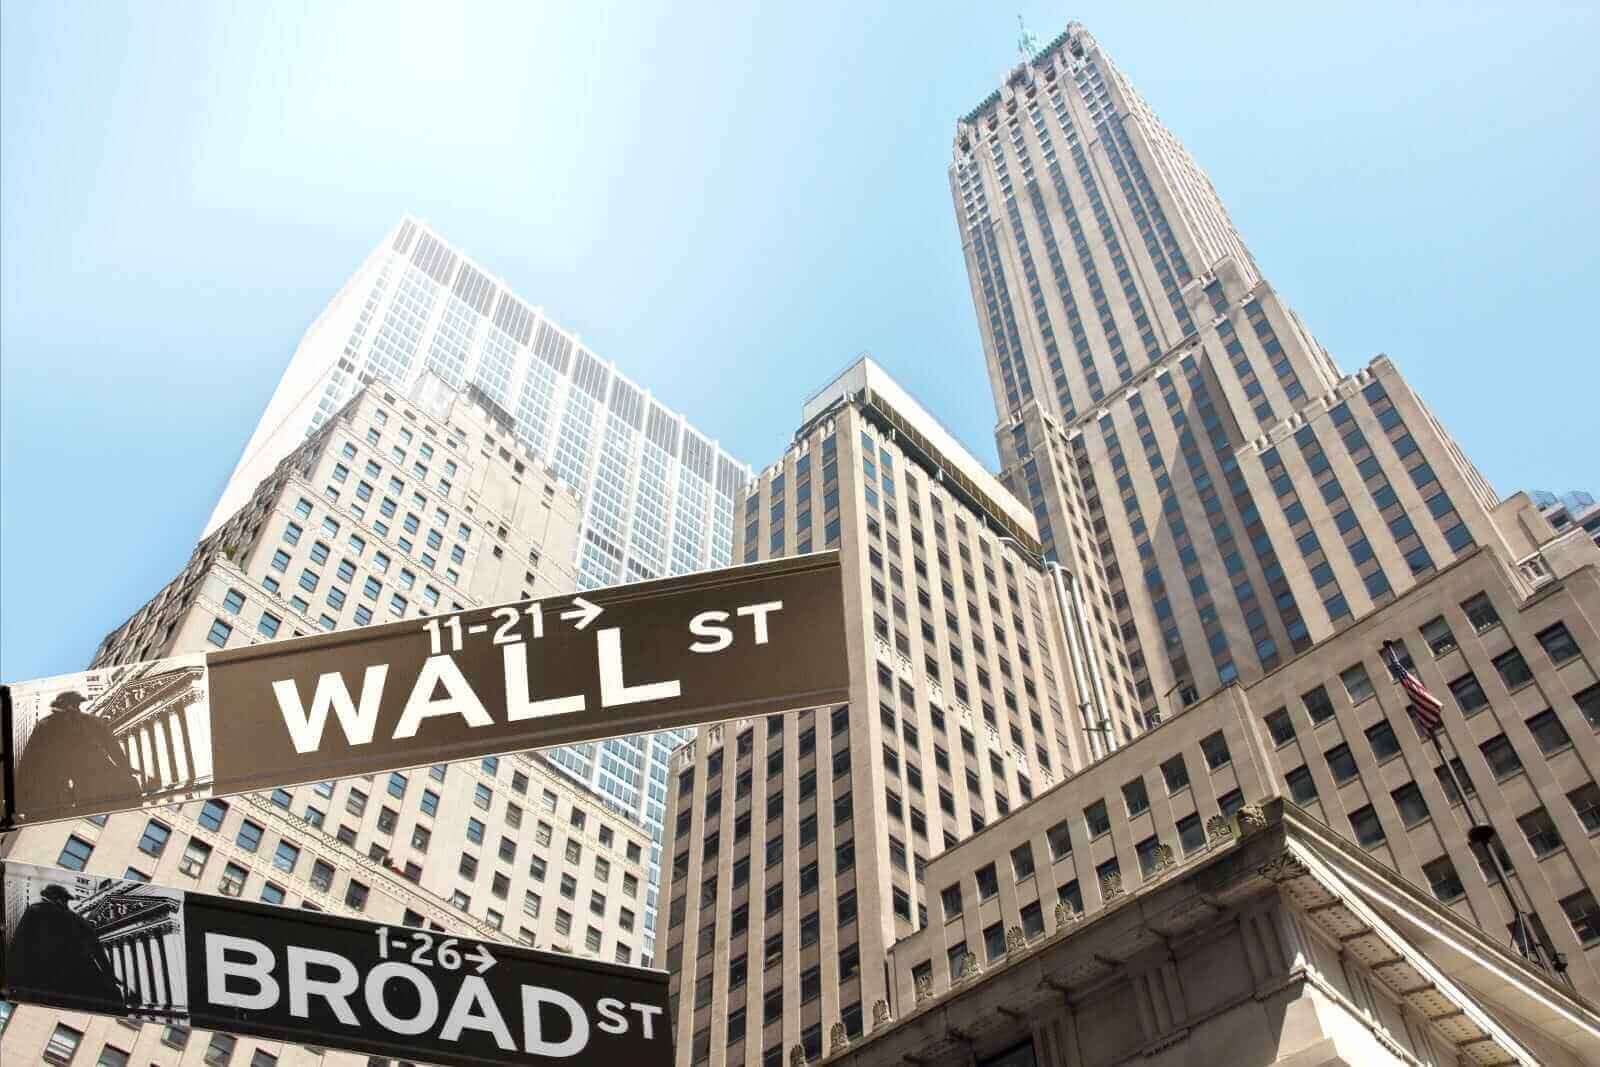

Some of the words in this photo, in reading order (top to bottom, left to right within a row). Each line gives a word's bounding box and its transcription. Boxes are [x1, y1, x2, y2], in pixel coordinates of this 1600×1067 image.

[422, 602, 545, 653] 11-21
[272, 627, 680, 754] WALL
[689, 601, 783, 652] ST
[376, 927, 460, 970] 1-26
[205, 932, 590, 1058] BROAD
[596, 998, 662, 1039] ST
